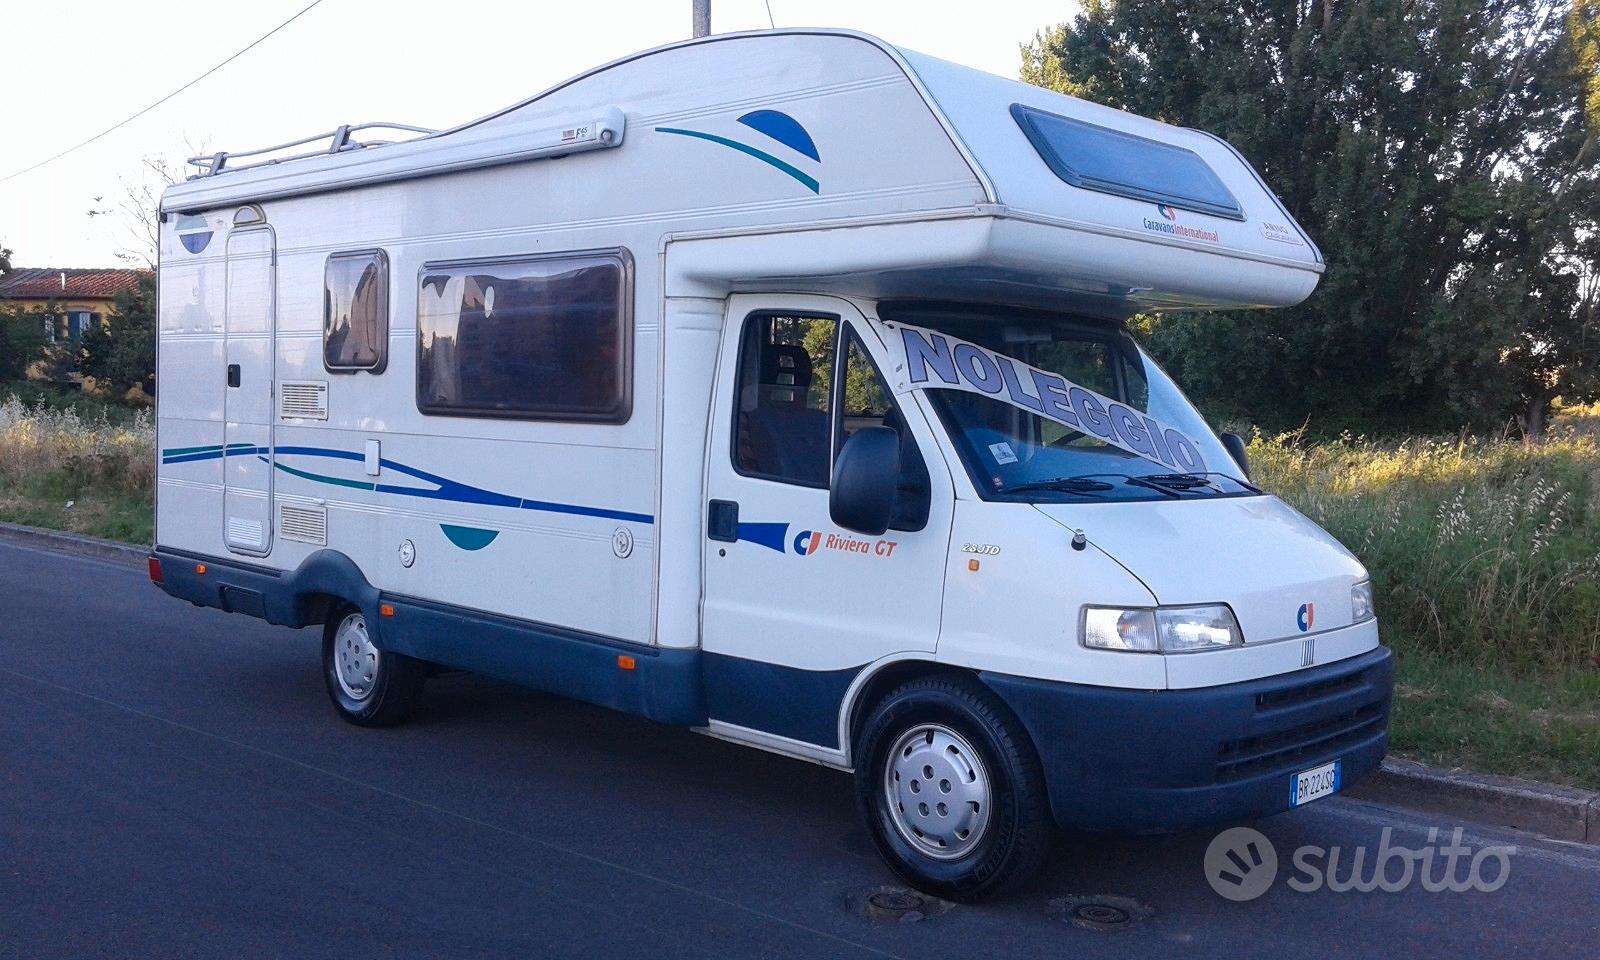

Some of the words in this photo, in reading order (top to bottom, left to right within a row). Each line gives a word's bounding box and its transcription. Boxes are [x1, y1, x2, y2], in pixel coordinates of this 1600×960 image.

[901, 327, 1208, 479] NOLEGGIO
[826, 533, 870, 554] Riviera
[875, 540, 898, 557] GT
[1299, 777, 1309, 799] BR
